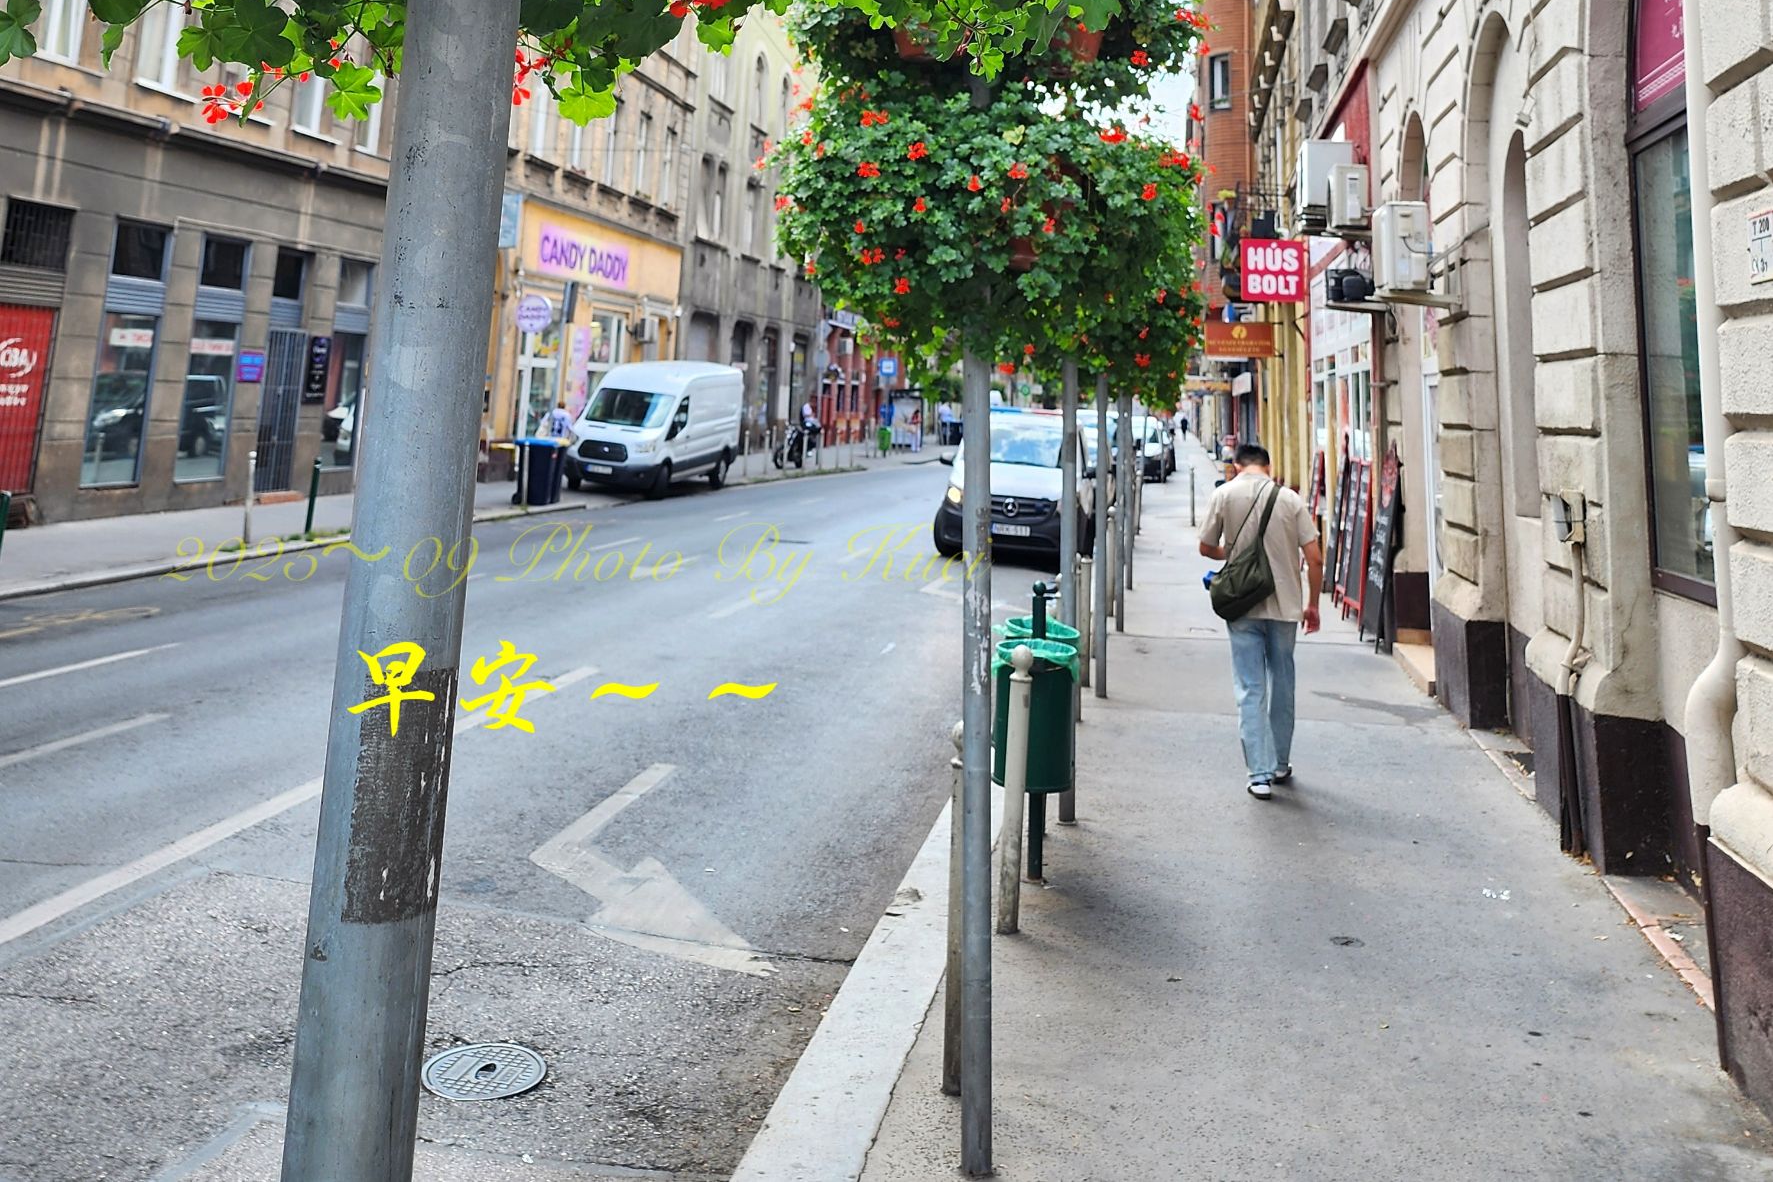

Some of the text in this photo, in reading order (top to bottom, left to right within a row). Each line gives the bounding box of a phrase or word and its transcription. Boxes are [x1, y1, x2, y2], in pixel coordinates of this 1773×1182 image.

[540, 235, 628, 281] CANDY DADDY
[1247, 241, 1299, 272] HÚS
[1247, 273, 1299, 295] BOLT
